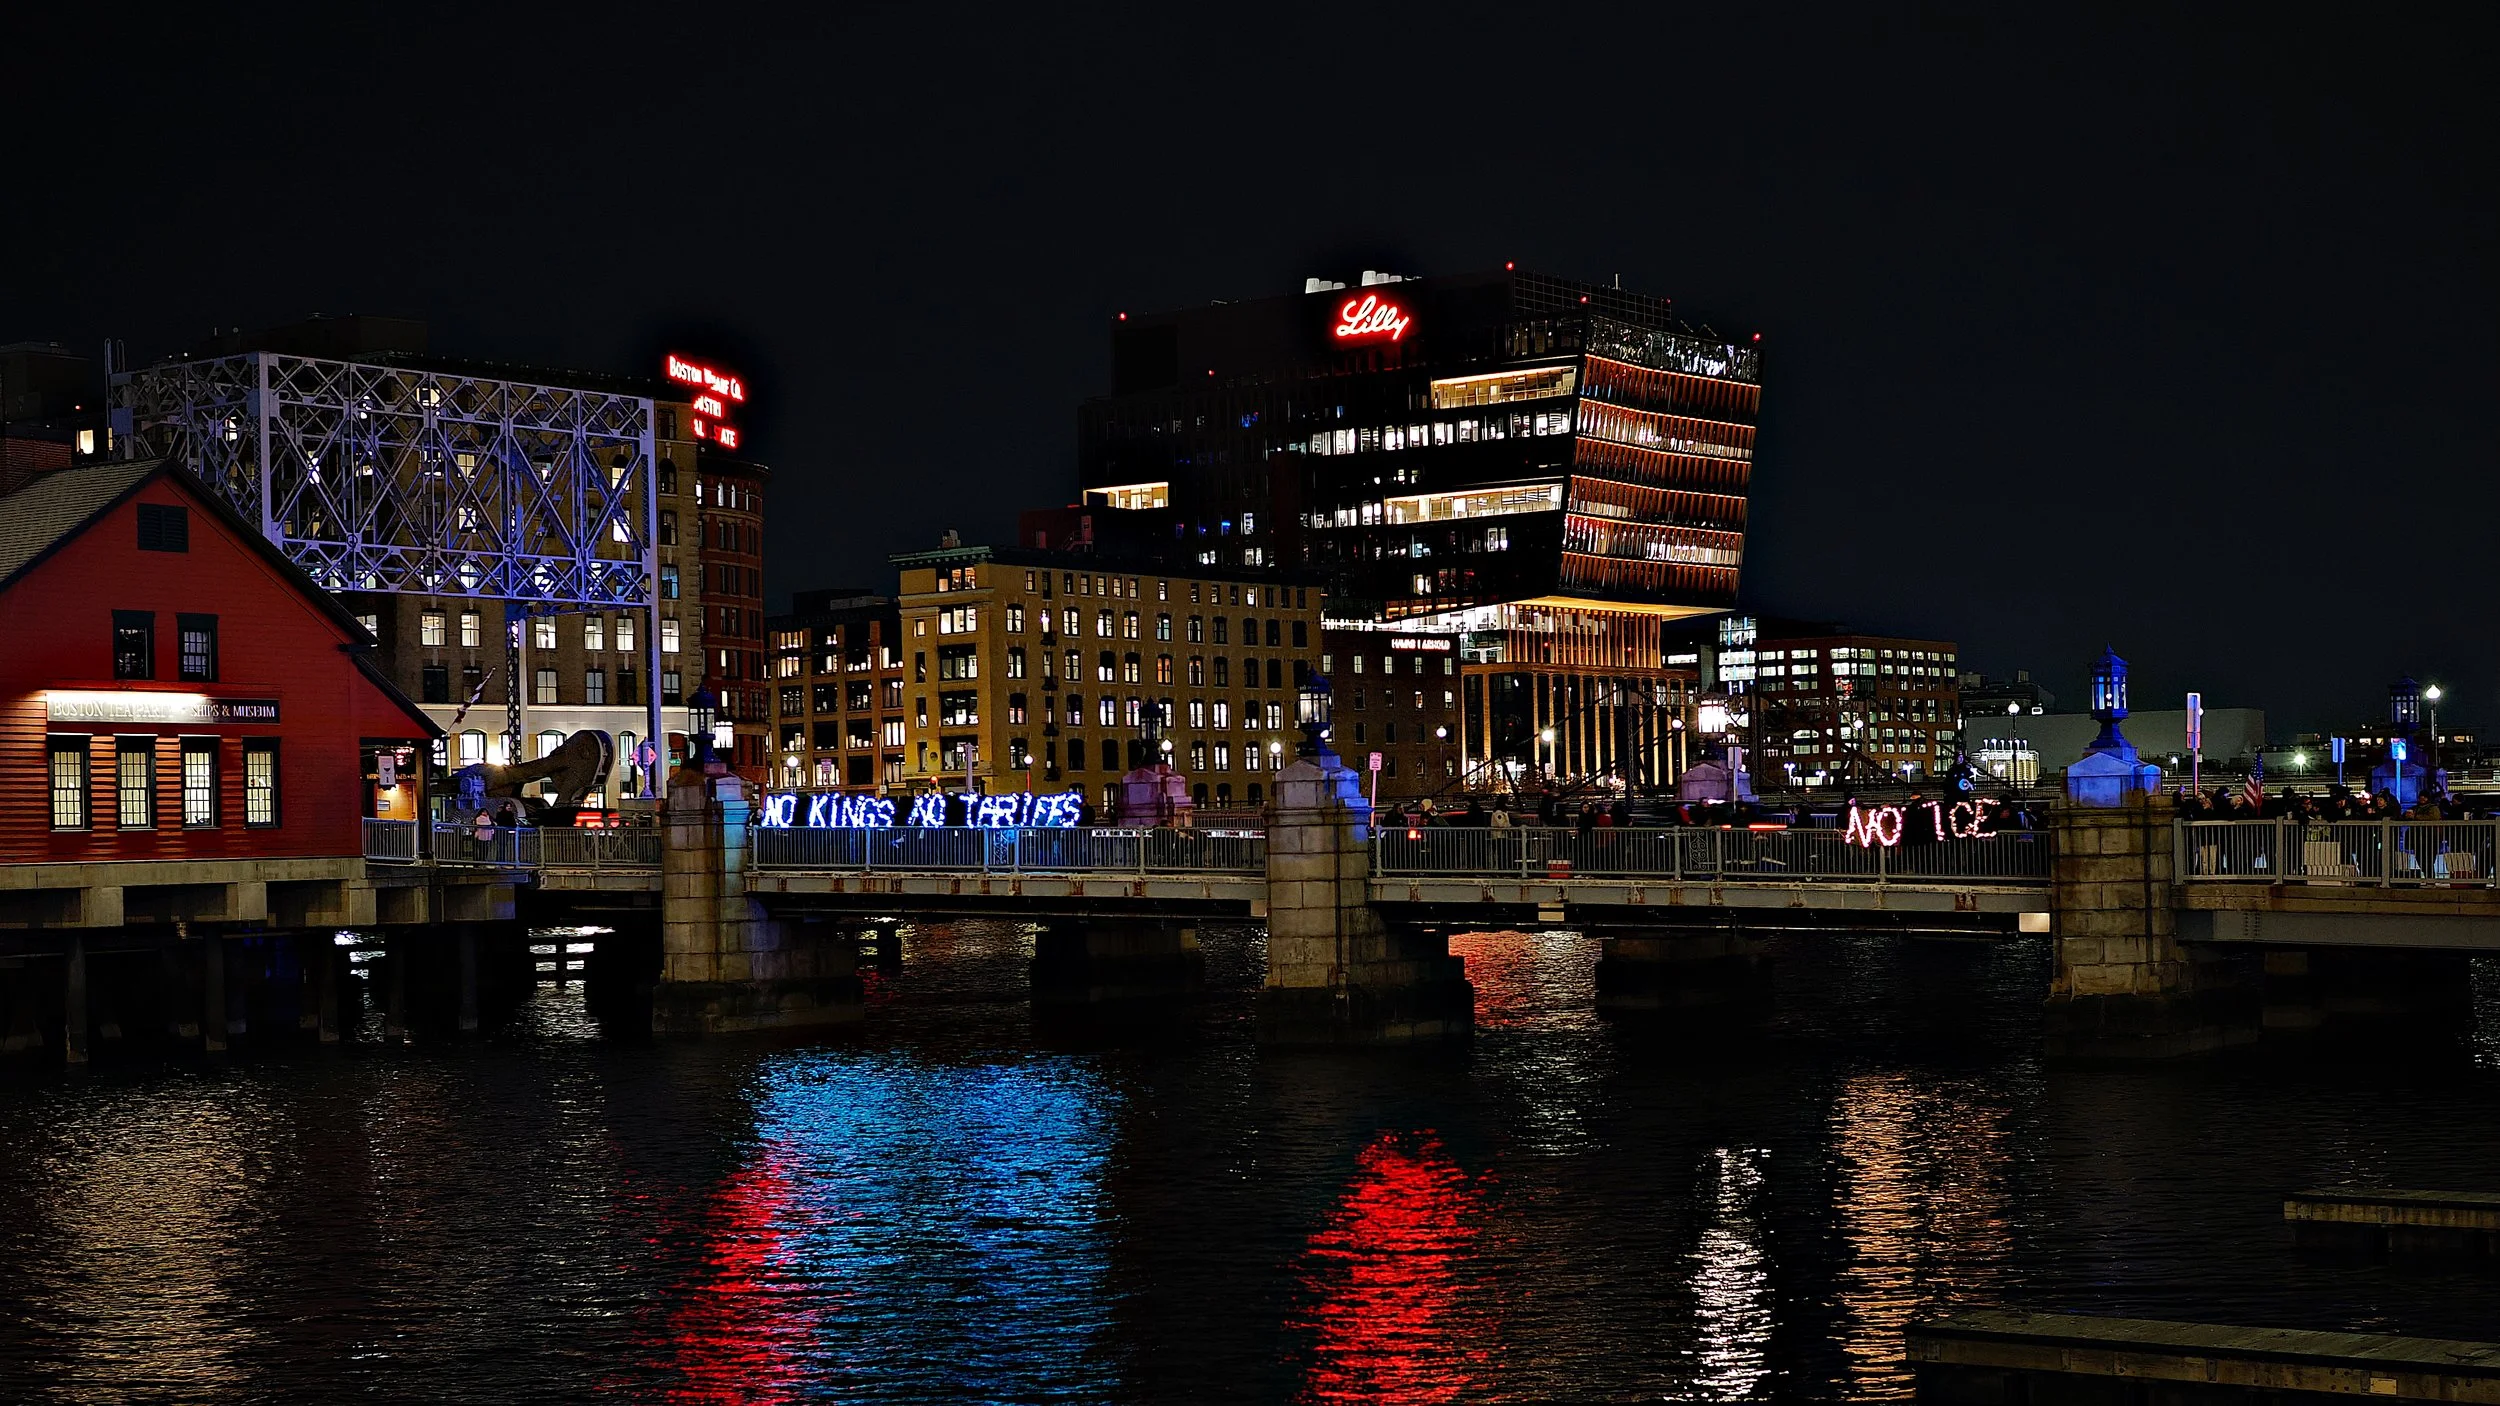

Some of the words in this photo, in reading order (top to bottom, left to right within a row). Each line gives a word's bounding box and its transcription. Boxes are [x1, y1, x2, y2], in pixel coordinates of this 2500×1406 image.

[1336, 294, 1410, 341] Lilly
[1422, 639, 1451, 650] ARNOLD
[53, 700, 104, 717] BOSTON
[108, 702, 134, 717] TEA
[190, 704, 220, 718] SHIPS
[221, 706, 230, 717] &
[233, 705, 275, 718] MUSEUM
[761, 794, 798, 829] NO
[808, 793, 896, 829] KINGS
[907, 793, 946, 829] NO
[959, 791, 1083, 830] TARIFFS
[1845, 805, 1907, 848] NO
